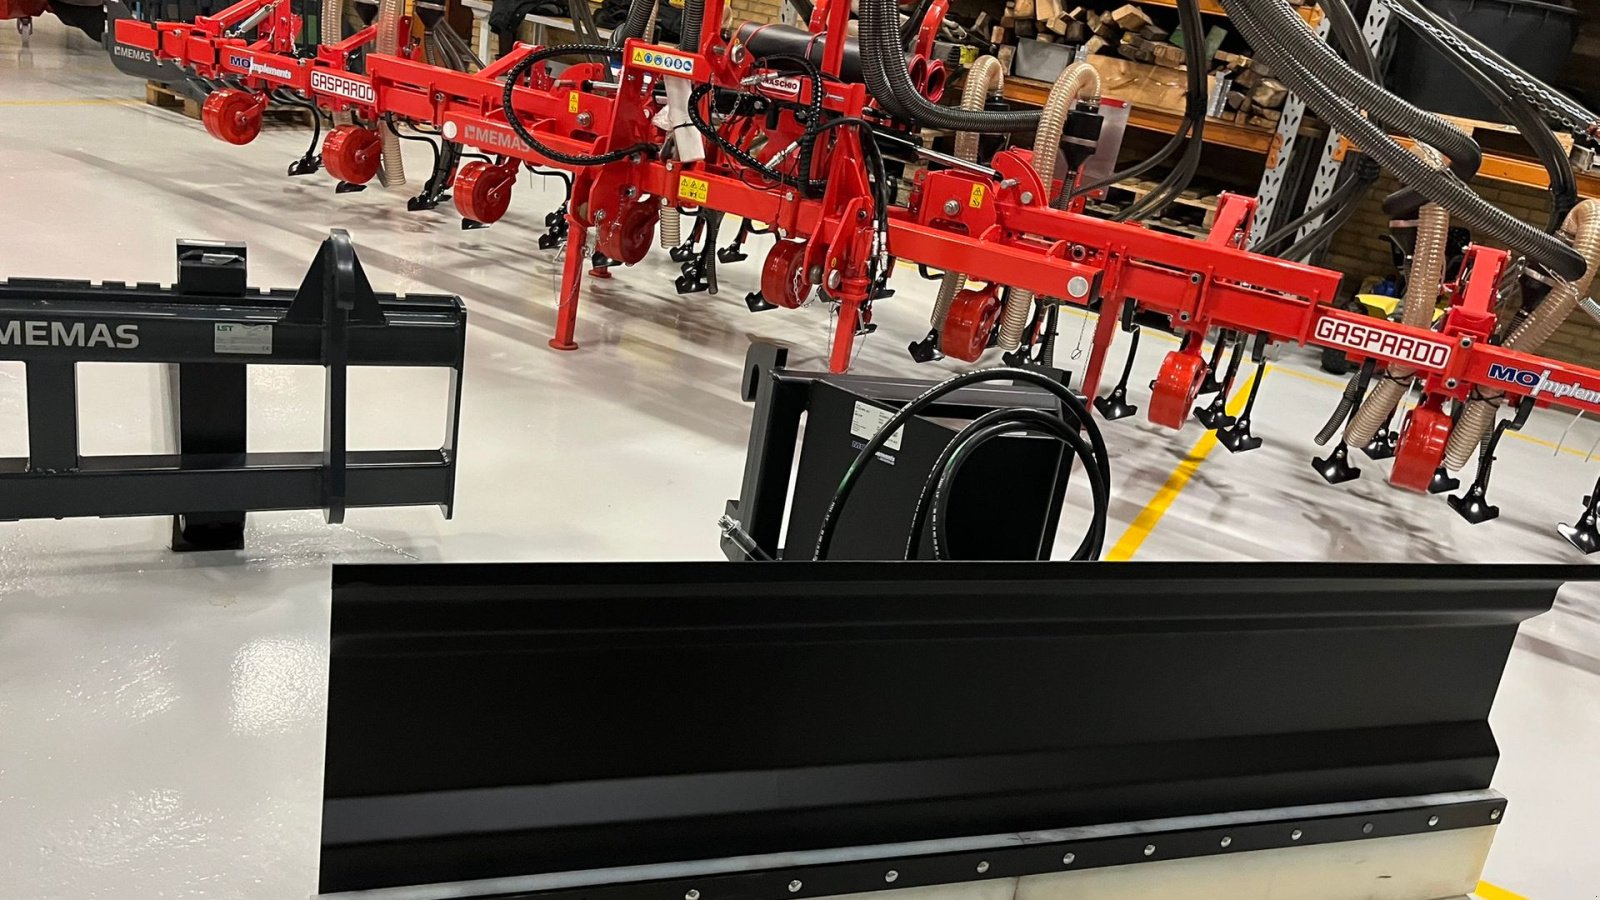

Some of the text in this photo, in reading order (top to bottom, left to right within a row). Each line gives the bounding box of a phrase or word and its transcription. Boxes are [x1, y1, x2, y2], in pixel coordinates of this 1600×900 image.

[120, 47, 151, 62] MEMAS
[312, 72, 374, 101] GASPARDO
[0, 320, 140, 349] MEMAS
[1317, 319, 1450, 367] GASPARDO
